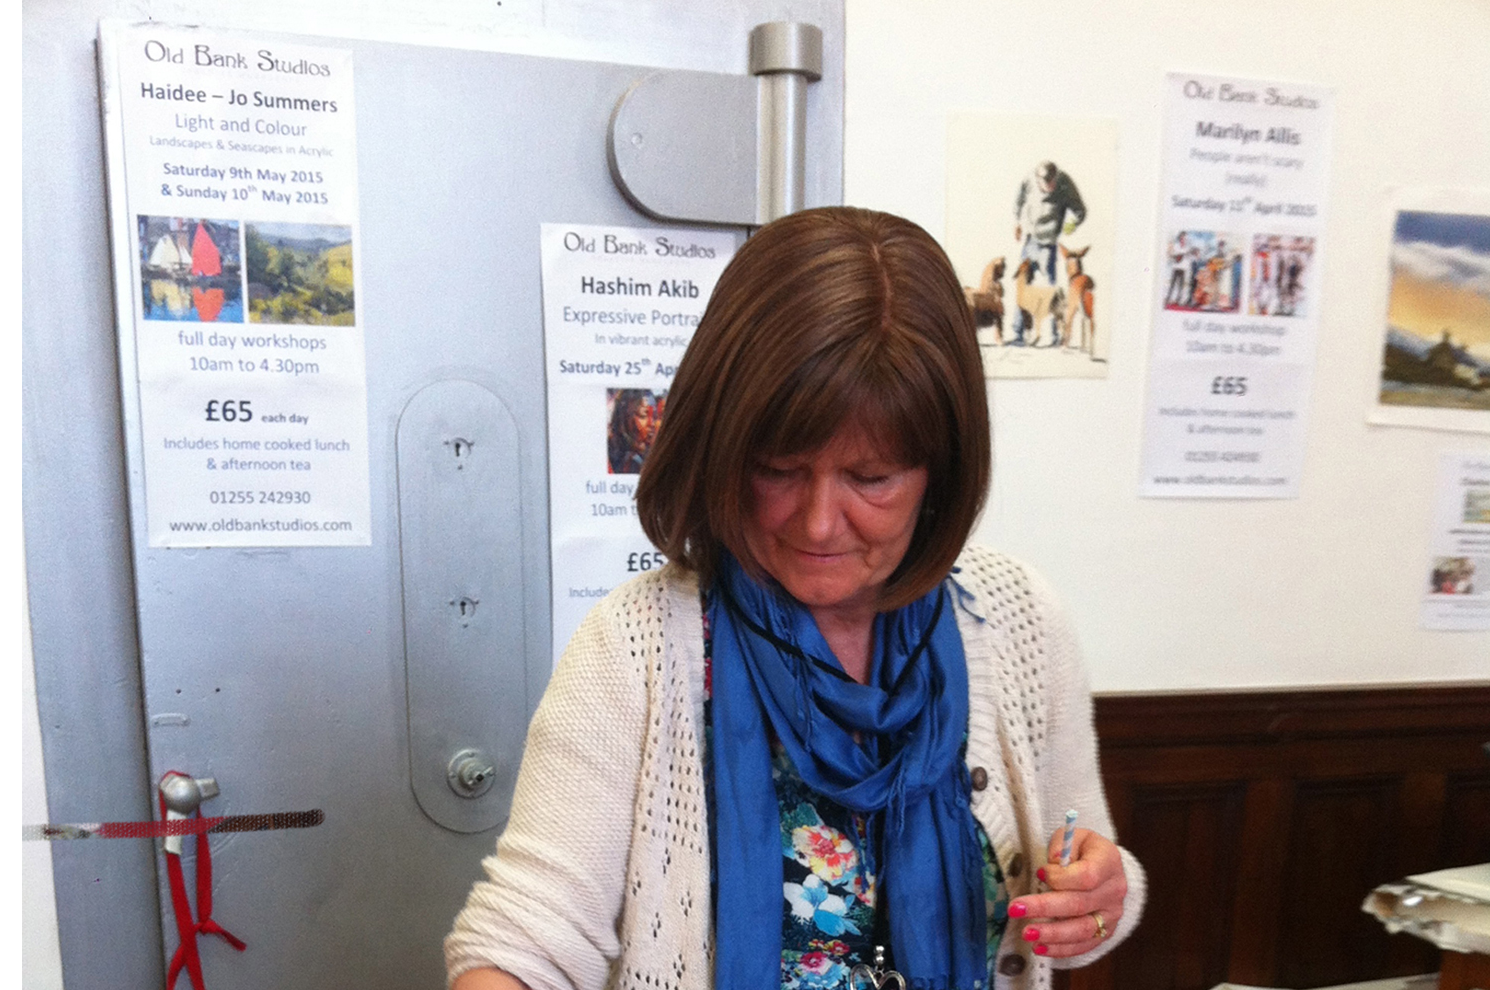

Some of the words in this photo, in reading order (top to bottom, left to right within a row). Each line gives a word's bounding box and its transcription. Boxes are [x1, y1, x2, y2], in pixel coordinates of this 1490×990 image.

[144, 40, 184, 64] Old
[194, 44, 248, 69] Bank
[257, 50, 331, 77] Studios
[140, 83, 207, 103] Haidee
[228, 90, 248, 106] Jo
[253, 91, 338, 113] Summers
[175, 114, 215, 132] Light
[220, 118, 250, 133] and
[255, 119, 307, 137] Colour
[149, 136, 213, 151] Landscapes
[216, 139, 225, 150] &
[228, 140, 283, 155] Seascapes
[286, 145, 296, 155] in
[298, 146, 334, 158] Acrylic
[163, 163, 225, 180] Saturday
[229, 167, 253, 180] 9th
[257, 169, 287, 184] May
[291, 171, 323, 184] 2015
[161, 184, 172, 197] &
[177, 185, 227, 201] Sunday
[232, 185, 258, 201] 10th
[262, 190, 292, 205] May
[295, 192, 329, 205] 2015
[563, 232, 596, 253] Old
[604, 234, 648, 257] Bank
[655, 236, 716, 260] Studios
[581, 276, 652, 297] Hashim
[658, 280, 700, 299] Akib
[563, 307, 647, 328] Expressive
[651, 309, 706, 327] Portra
[178, 331, 204, 347] full
[208, 332, 237, 350] day
[242, 334, 327, 351] workshops
[608, 333, 649, 346] vibrant
[190, 357, 233, 372] 10am
[238, 359, 255, 372] to
[260, 359, 319, 376] 4.30pm
[560, 360, 621, 377] Saturday
[1211, 376, 1248, 396] £65
[205, 400, 253, 422] £65
[261, 413, 286, 424] each
[288, 413, 309, 425] day
[163, 437, 219, 450] Includes
[223, 438, 260, 451] home
[264, 438, 311, 451] cooked
[315, 439, 350, 452] lunch
[206, 458, 217, 470] &
[221, 458, 286, 471] afternoon
[290, 459, 311, 471] tea
[210, 491, 254, 504] 01255
[259, 491, 311, 504] 242930
[585, 480, 607, 494] full
[611, 481, 634, 498] day
[591, 503, 628, 516] 10am
[169, 518, 352, 532] www.oldbankstudios.com
[627, 552, 664, 572] £65
